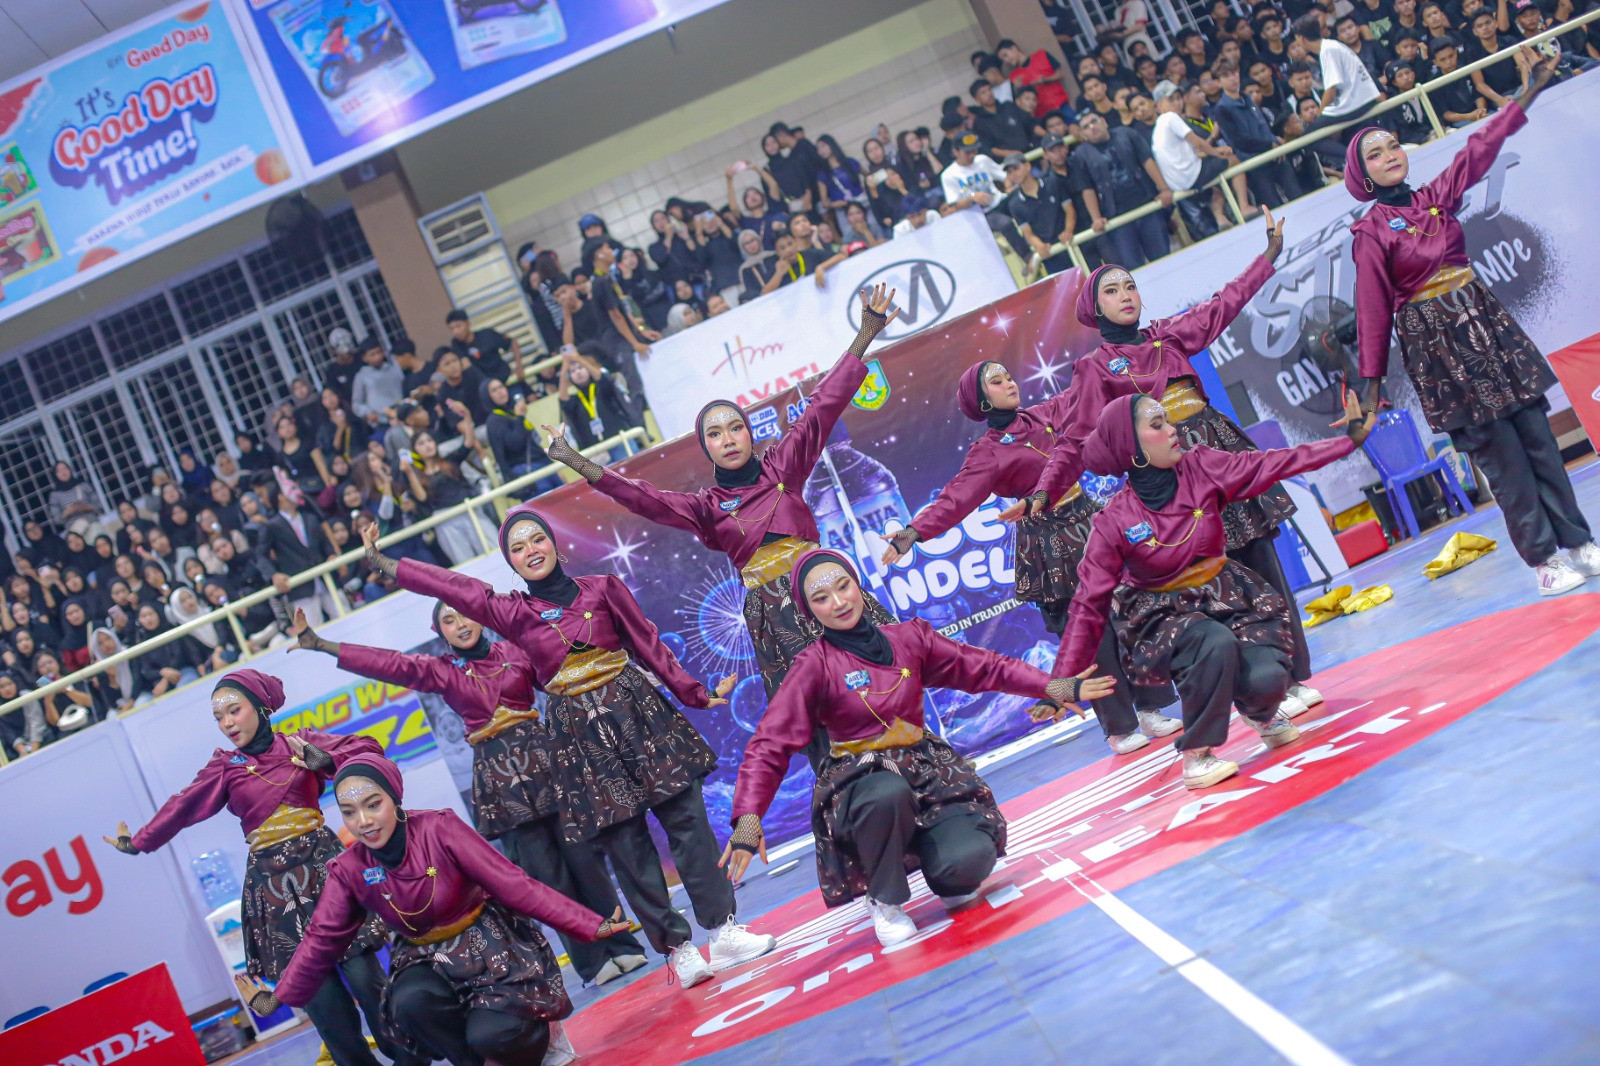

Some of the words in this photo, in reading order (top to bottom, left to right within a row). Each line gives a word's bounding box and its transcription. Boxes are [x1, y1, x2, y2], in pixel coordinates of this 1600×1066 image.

[126, 35, 172, 69] Good
[171, 24, 210, 49] Day
[55, 95, 146, 170] Good
[144, 66, 214, 119] Day
[75, 87, 116, 123] It's
[100, 110, 198, 190] Time!
[959, 617, 973, 631] IN
[986, 702, 1448, 909] HEART.
[55, 1020, 174, 1066] NDA
